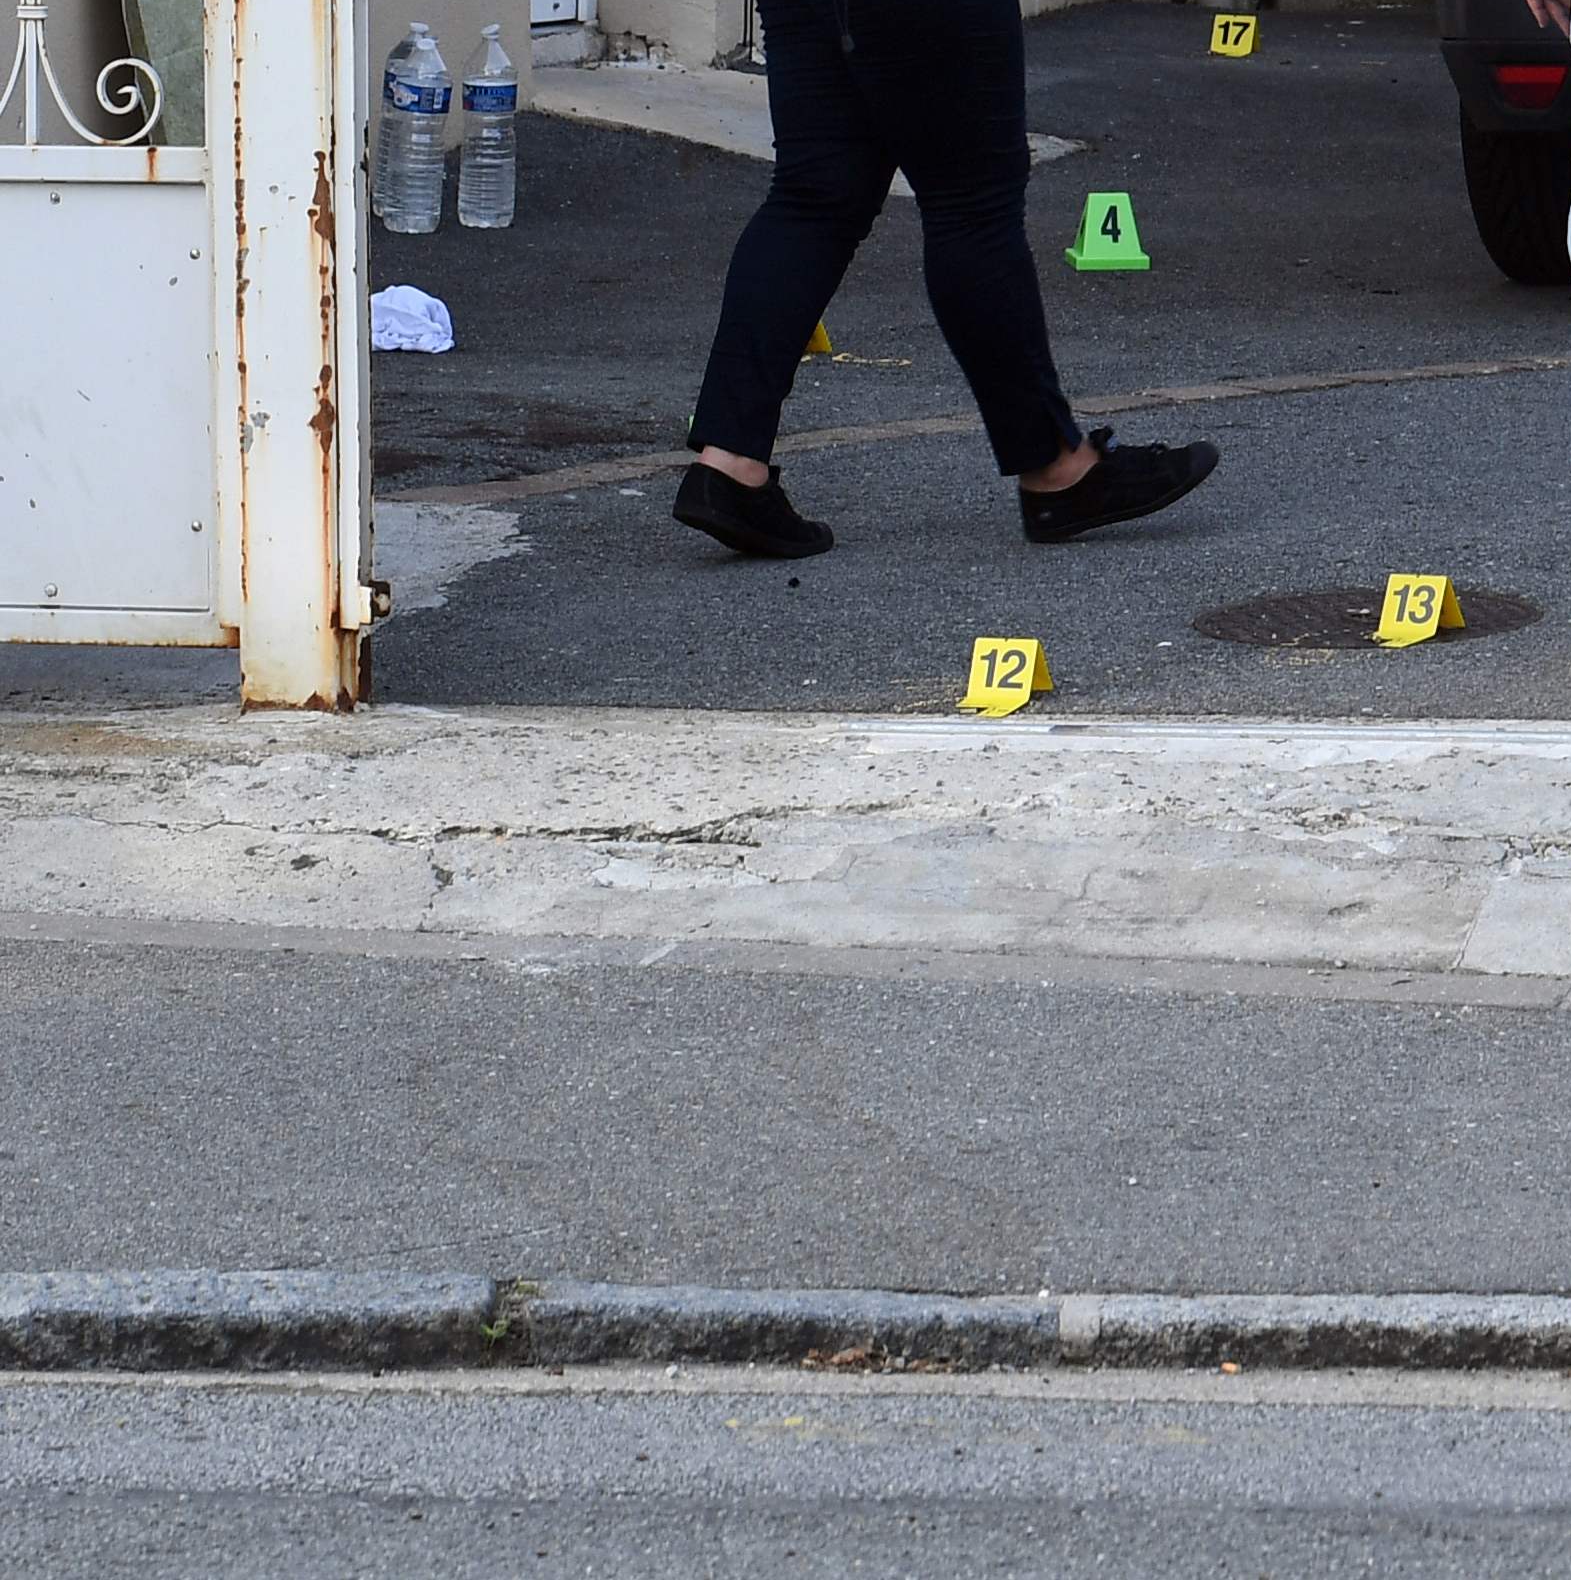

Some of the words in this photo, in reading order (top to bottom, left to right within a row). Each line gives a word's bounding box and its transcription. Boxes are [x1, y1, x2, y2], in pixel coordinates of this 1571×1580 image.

[1217, 20, 1251, 47] 17
[1100, 204, 1121, 244] 4
[1392, 583, 1437, 625] 13
[979, 648, 1028, 690] 12
